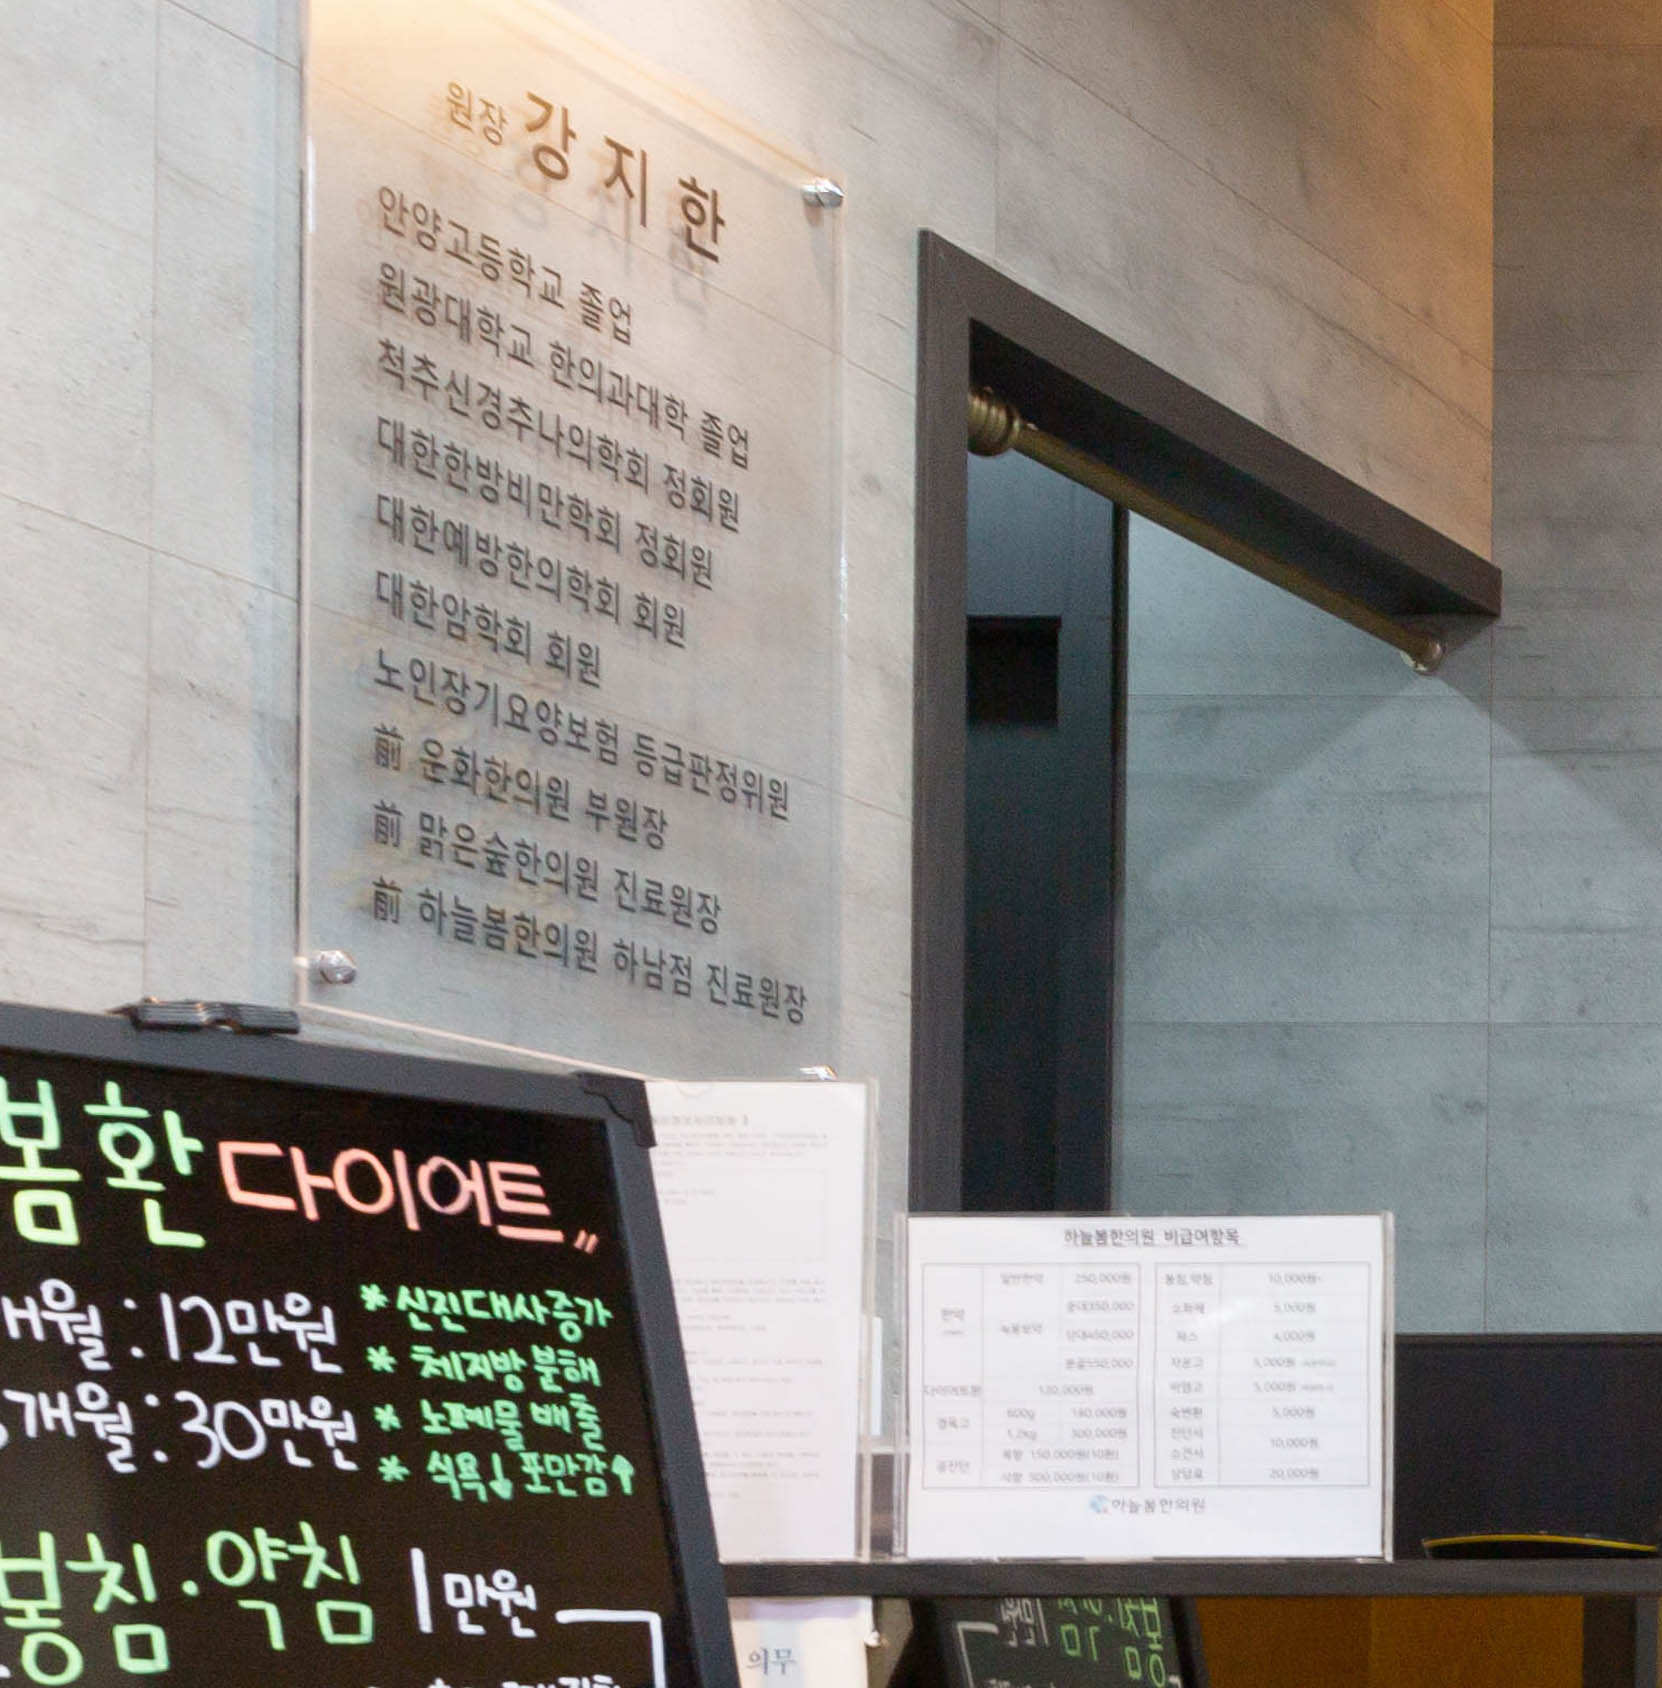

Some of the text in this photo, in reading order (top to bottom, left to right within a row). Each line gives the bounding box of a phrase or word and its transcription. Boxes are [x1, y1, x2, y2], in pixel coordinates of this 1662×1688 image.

[447, 81, 507, 147] 원장
[378, 185, 631, 346] 안양고등학교 졸업
[378, 263, 749, 470] 원광대학교 한의과대학 졸업
[378, 339, 740, 533] 척추신경추나의학회 정회원
[378, 416, 713, 590] 대한한방비만학회 정회원
[375, 570, 600, 688] 대한암학회 회원
[377, 494, 686, 648] 대한예방한의학회 회원
[374, 649, 788, 820] 노인장기요양보험 등급판정위원
[419, 810, 599, 902] 맑은숲한의원
[613, 867, 720, 935] 진료원장
[585, 789, 667, 851] 부원장
[418, 888, 598, 974] 하늘봄한의원
[613, 938, 693, 997] 하남점
[706, 963, 807, 1025] 진료원장
[219, 1141, 564, 1242] 다이어트
[396, 1284, 614, 1342] 신진대사증가
[410, 1344, 601, 1393] 체지방 분해
[426, 1450, 609, 1502] 식욕 포만감
[529, 1392, 606, 1452] 배출
